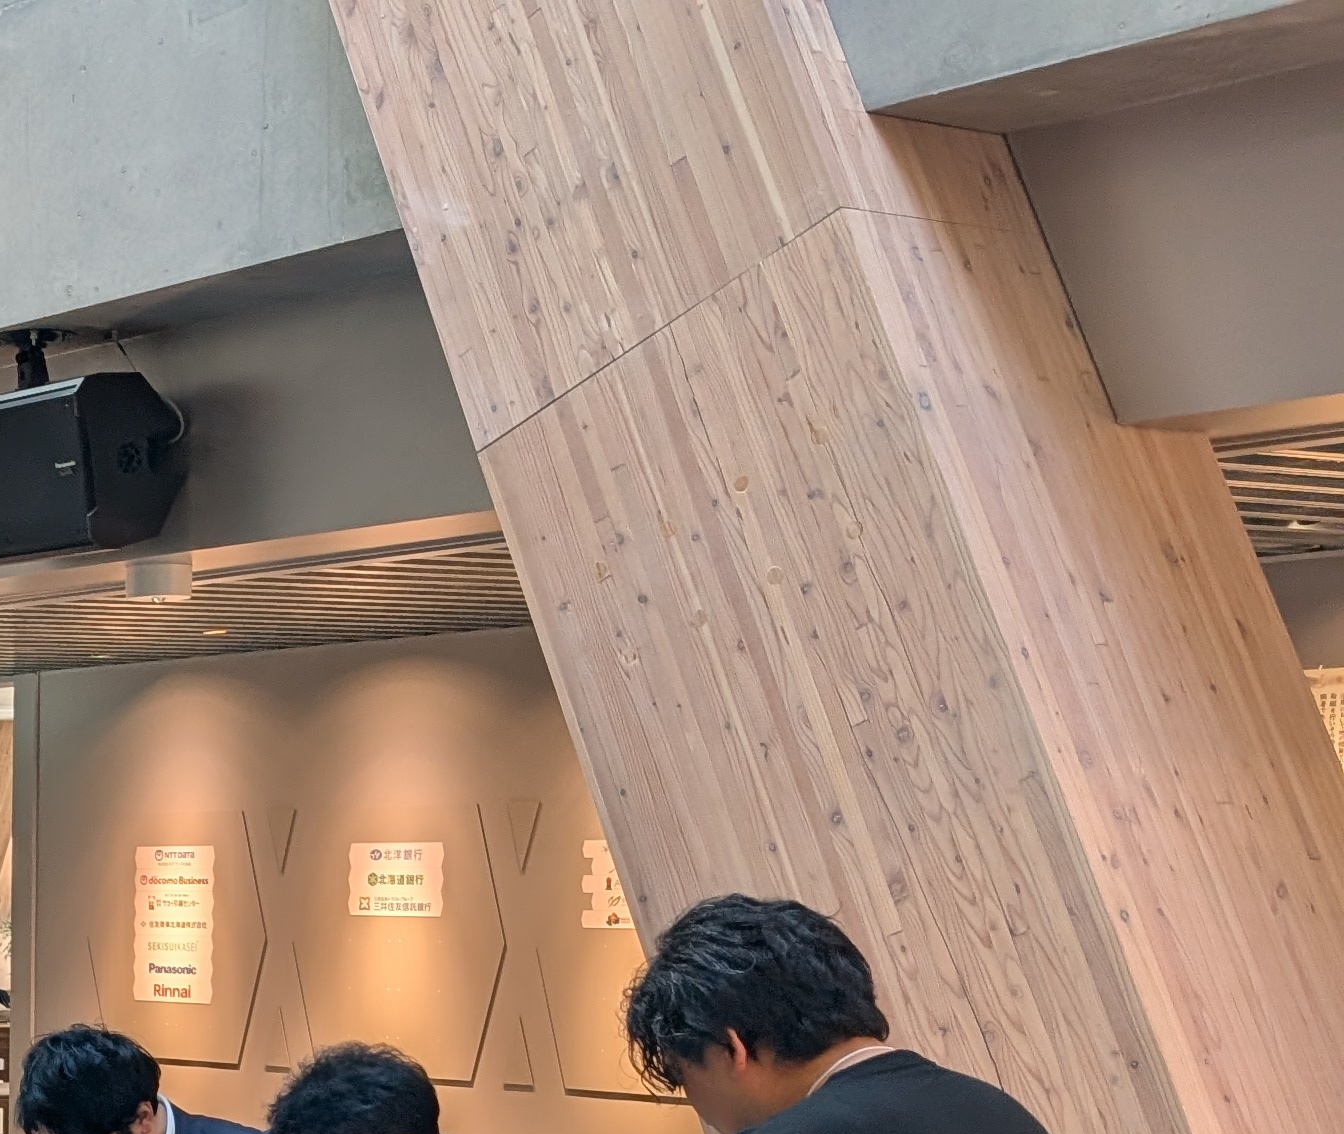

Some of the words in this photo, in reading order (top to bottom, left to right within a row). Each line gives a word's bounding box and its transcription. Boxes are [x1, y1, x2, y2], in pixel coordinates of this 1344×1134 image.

[384, 849, 423, 860] 北洋銀行
[149, 876, 178, 885] docomo
[178, 876, 209, 885] Business
[378, 874, 424, 886] 北海道銀行
[148, 962, 197, 975] Panasonic
[153, 983, 192, 999] Rinnai
